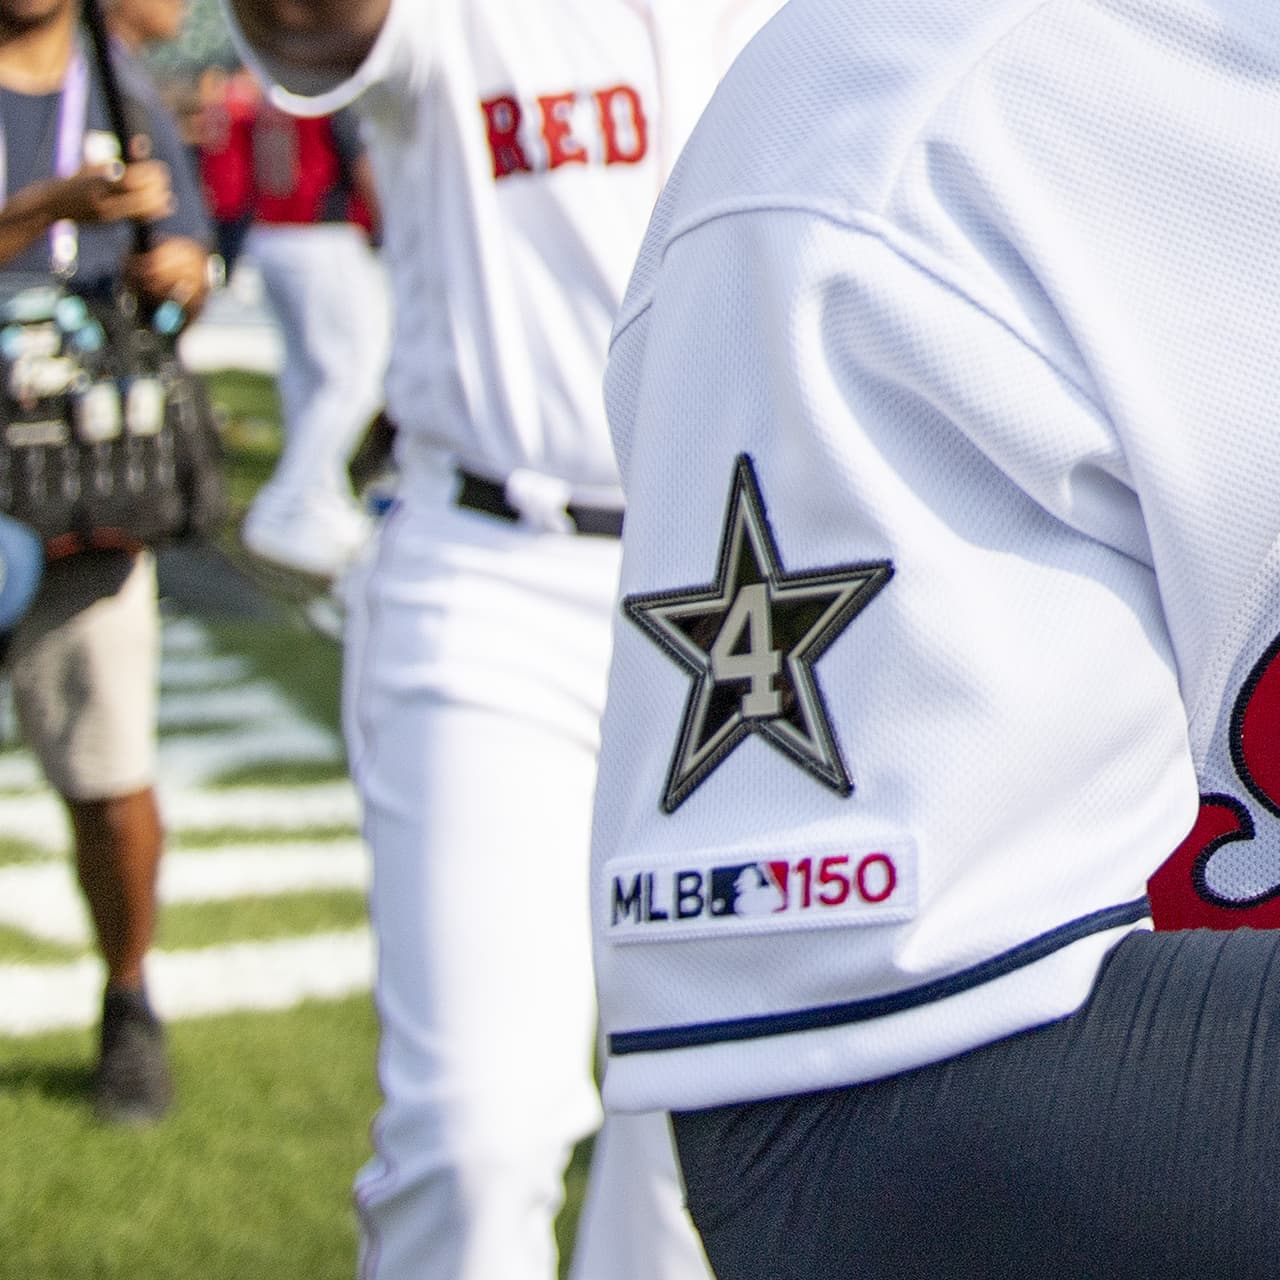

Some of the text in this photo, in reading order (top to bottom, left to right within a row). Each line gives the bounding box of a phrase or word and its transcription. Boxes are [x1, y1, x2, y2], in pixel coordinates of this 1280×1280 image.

[480, 85, 649, 183] RED
[711, 583, 783, 718] 4
[611, 852, 897, 926] MLB 150
